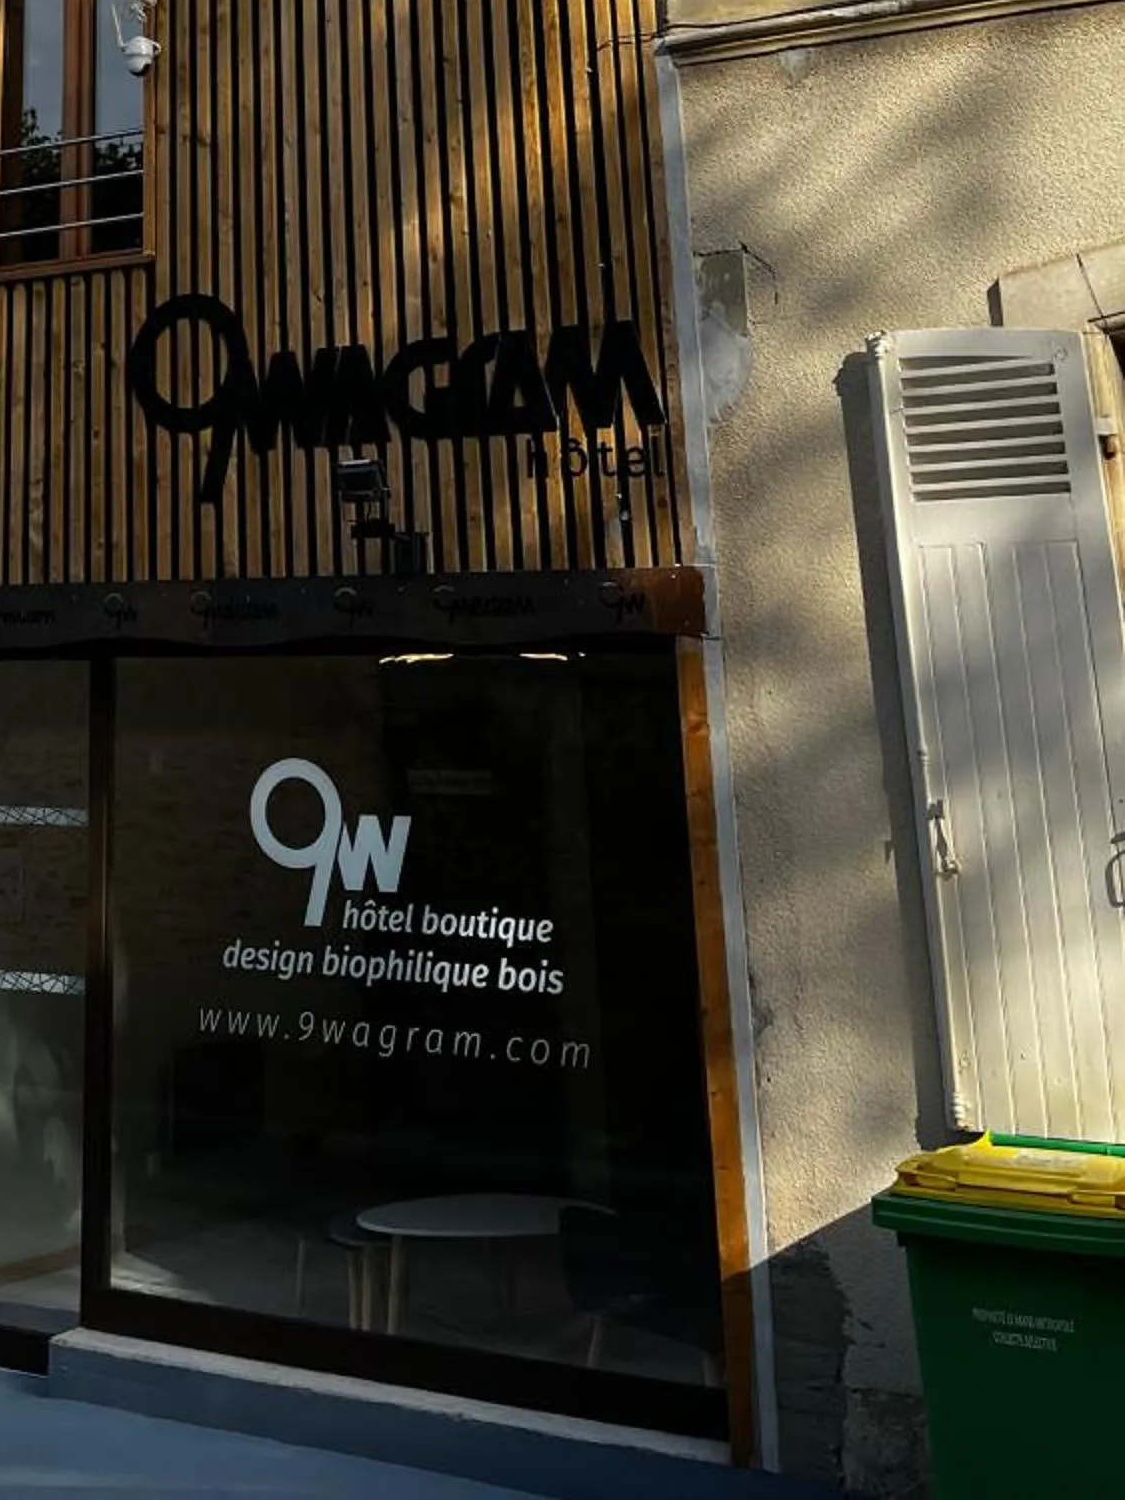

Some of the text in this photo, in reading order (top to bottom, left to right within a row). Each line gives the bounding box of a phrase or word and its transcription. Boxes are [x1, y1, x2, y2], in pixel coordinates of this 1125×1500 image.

[526, 430, 665, 479] hôtel
[342, 899, 555, 949] hôtel boutique
[222, 938, 565, 996] design biophilique bois
[198, 1006, 591, 1070] www.9wagram.com
